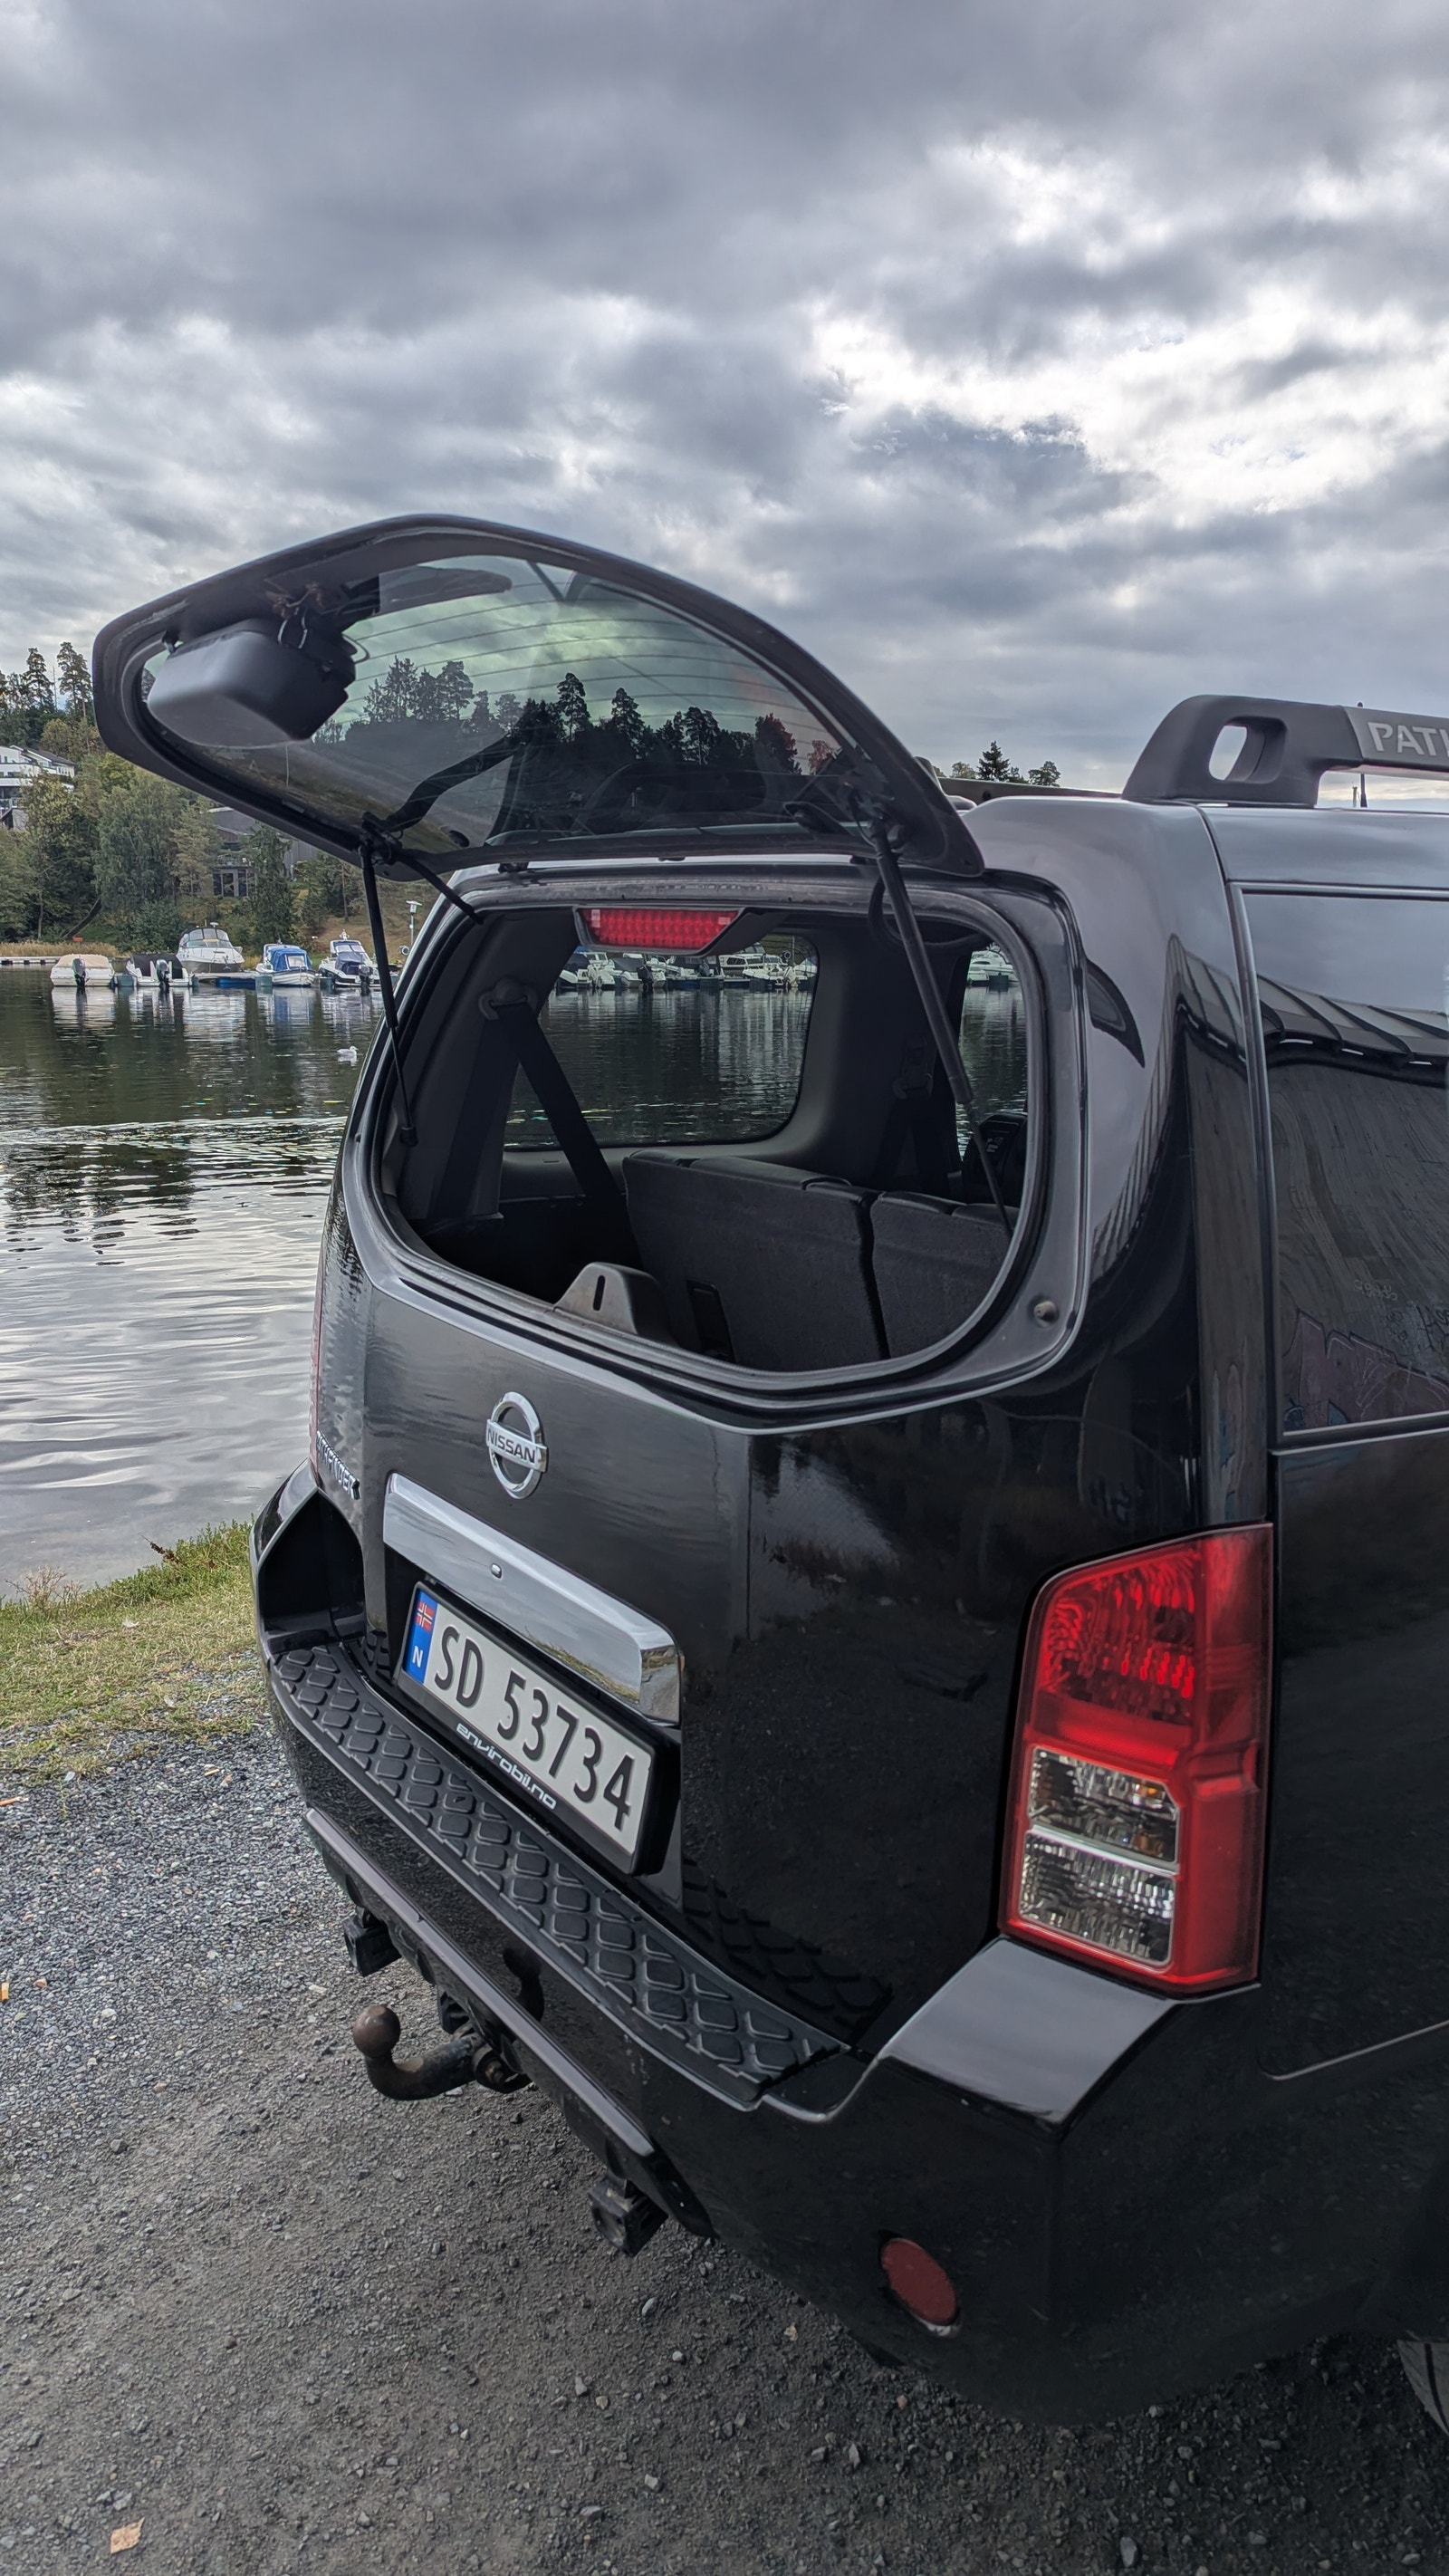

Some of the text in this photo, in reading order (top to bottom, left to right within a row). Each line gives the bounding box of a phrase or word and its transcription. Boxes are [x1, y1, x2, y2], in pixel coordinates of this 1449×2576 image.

[488, 1428, 535, 1464] NISSAN
[412, 1646, 423, 1668] N
[435, 1626, 635, 1831] SD 53734
[456, 1723, 557, 1810] envirobil.no
